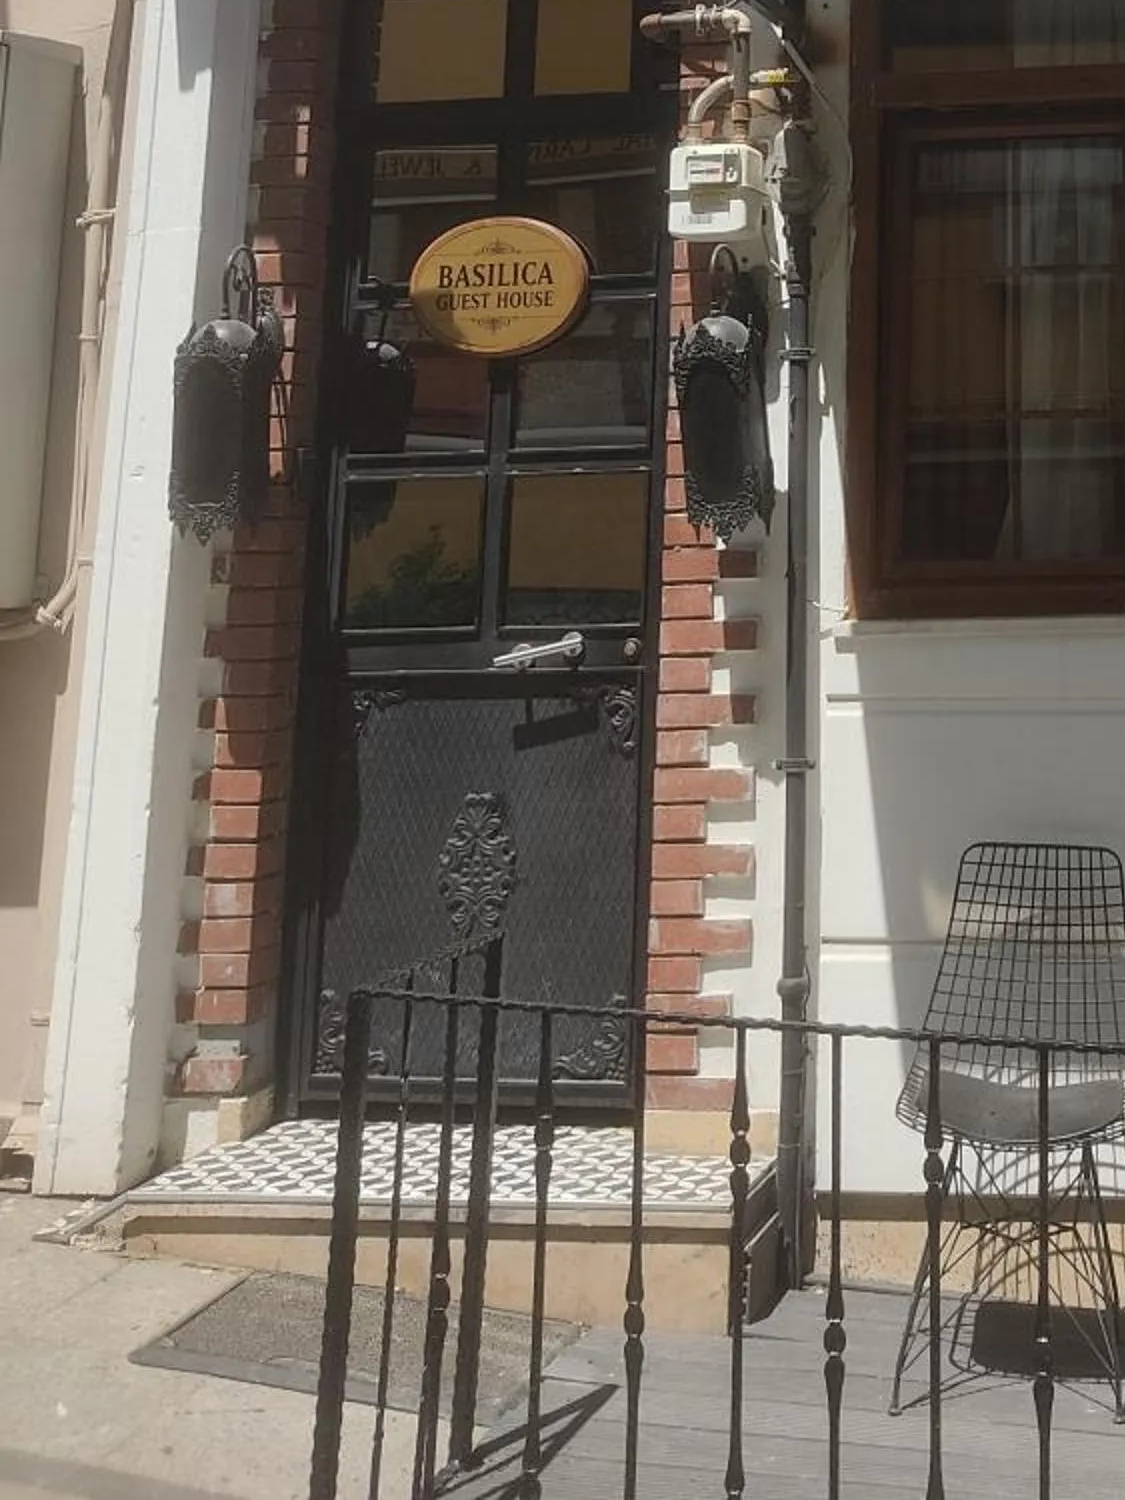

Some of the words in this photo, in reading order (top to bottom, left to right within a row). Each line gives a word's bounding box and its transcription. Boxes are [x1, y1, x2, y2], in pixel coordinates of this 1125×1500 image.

[438, 261, 554, 289] BASILICA
[436, 293, 491, 311] GUEST
[496, 290, 554, 308] HOUSE
